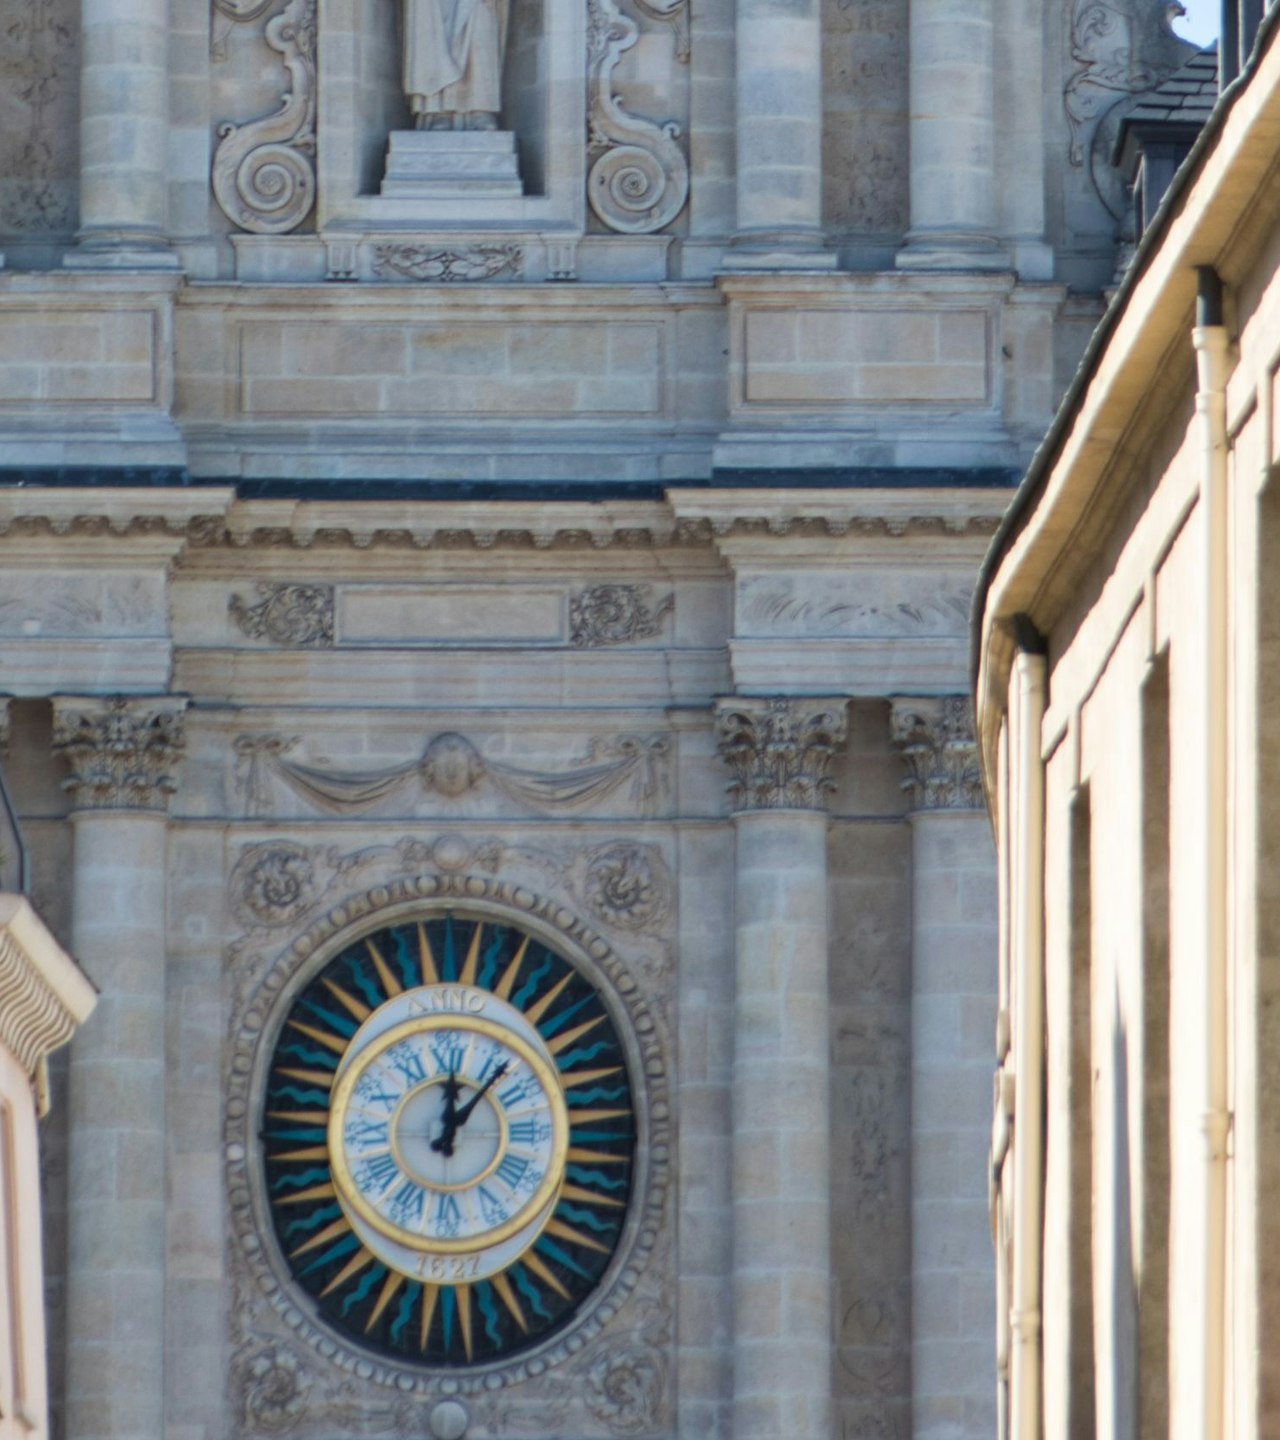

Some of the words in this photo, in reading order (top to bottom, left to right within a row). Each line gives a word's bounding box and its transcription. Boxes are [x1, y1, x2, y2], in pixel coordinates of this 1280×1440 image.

[408, 987, 487, 1016] ANNO
[395, 1053, 426, 1087] XI
[431, 1047, 465, 1073] XII
[369, 1081, 400, 1113] X
[498, 1083, 526, 1109] II
[357, 1120, 388, 1146] IX
[509, 1119, 534, 1145] III
[366, 1153, 400, 1195] VIII
[395, 1182, 424, 1215] VII
[438, 1193, 461, 1219] VI
[416, 1254, 482, 1281] 1627
